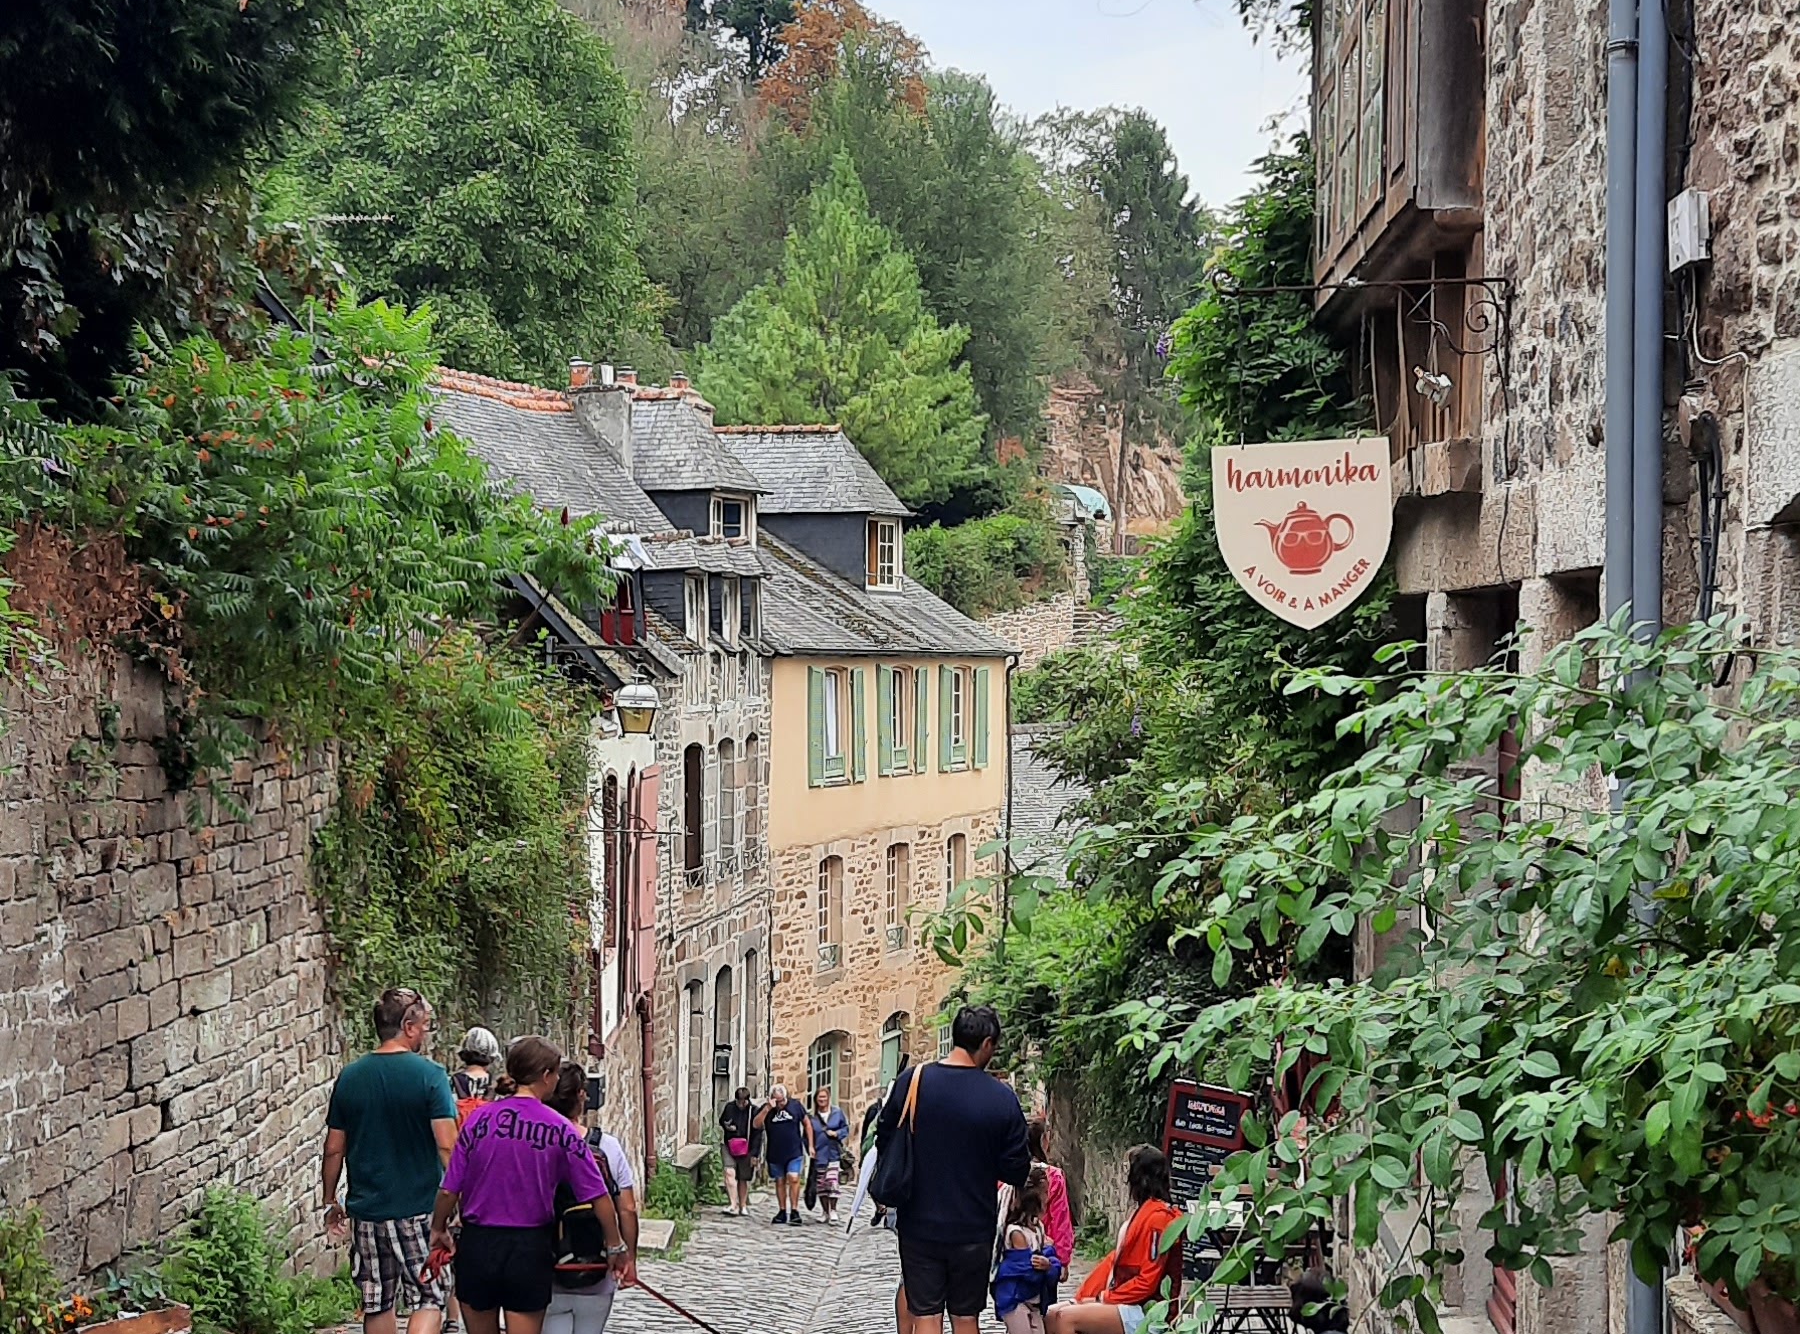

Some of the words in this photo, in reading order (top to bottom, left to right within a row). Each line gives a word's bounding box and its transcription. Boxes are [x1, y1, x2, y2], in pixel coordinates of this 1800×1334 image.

[1227, 451, 1380, 493] harmonika
[1257, 573, 1287, 604] VOIR
[1288, 597, 1298, 609] &
[1318, 558, 1371, 608] MANGER
[491, 1108, 587, 1158] Angeles
